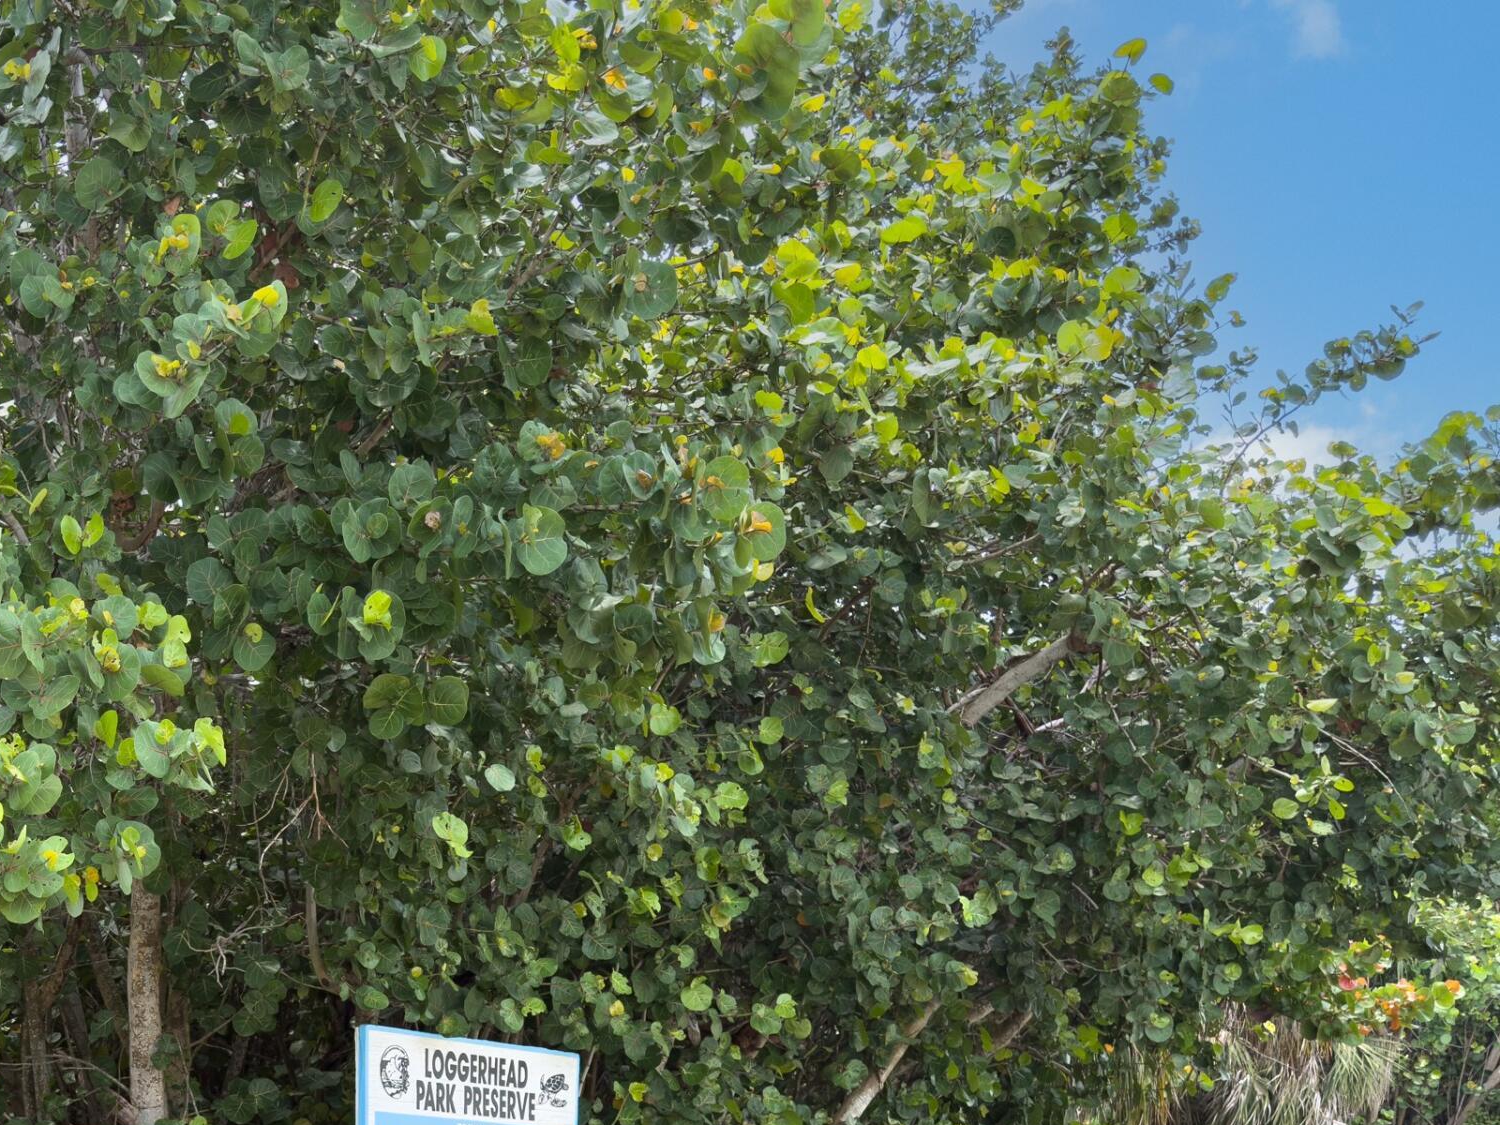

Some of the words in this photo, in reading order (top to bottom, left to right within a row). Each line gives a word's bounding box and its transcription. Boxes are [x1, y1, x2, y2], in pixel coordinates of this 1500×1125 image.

[425, 1048, 528, 1088] LOGGERHEAD
[416, 1080, 456, 1113] PARK
[464, 1086, 536, 1121] PRESERVE
